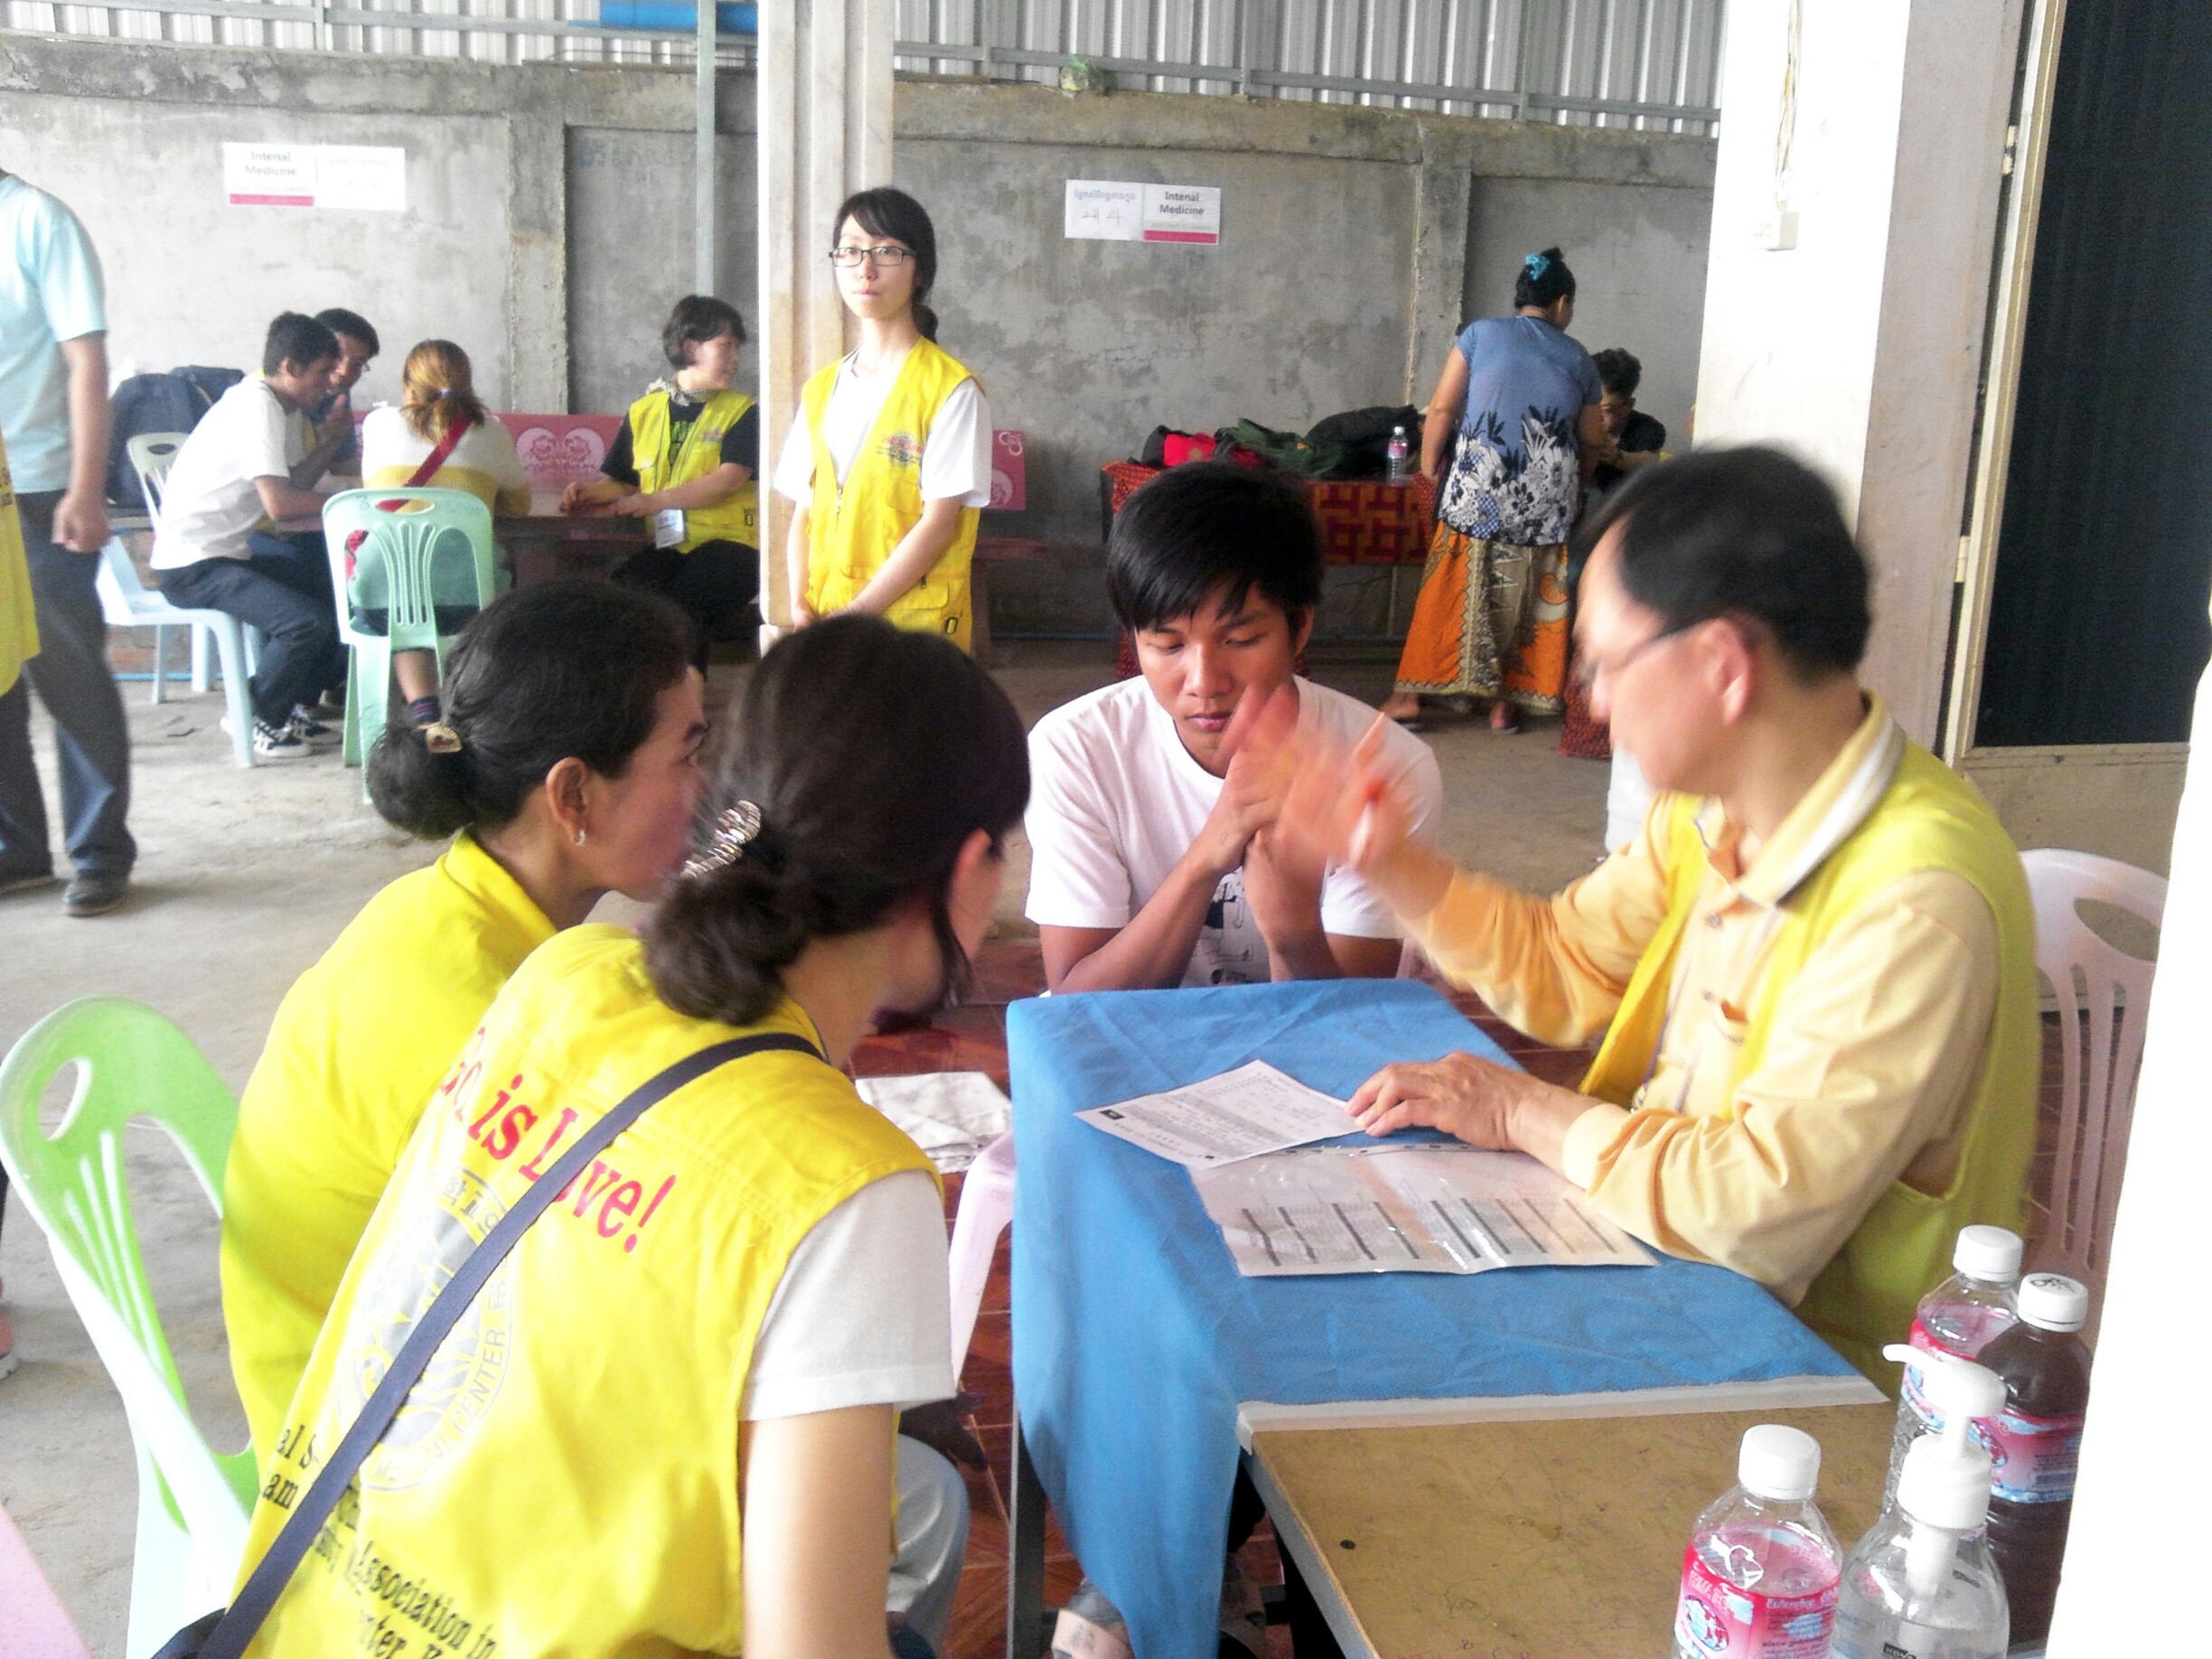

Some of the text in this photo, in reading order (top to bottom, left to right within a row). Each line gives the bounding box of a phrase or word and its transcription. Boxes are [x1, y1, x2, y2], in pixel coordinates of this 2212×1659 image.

[250, 150, 291, 163] Intenal
[245, 164, 297, 177] Medicine
[1165, 191, 1200, 202] Intenal
[1159, 204, 1204, 216] Medicine
[467, 1073, 539, 1161] is
[519, 1107, 677, 1253] Lve!
[450, 1328, 506, 1435] CENTER
